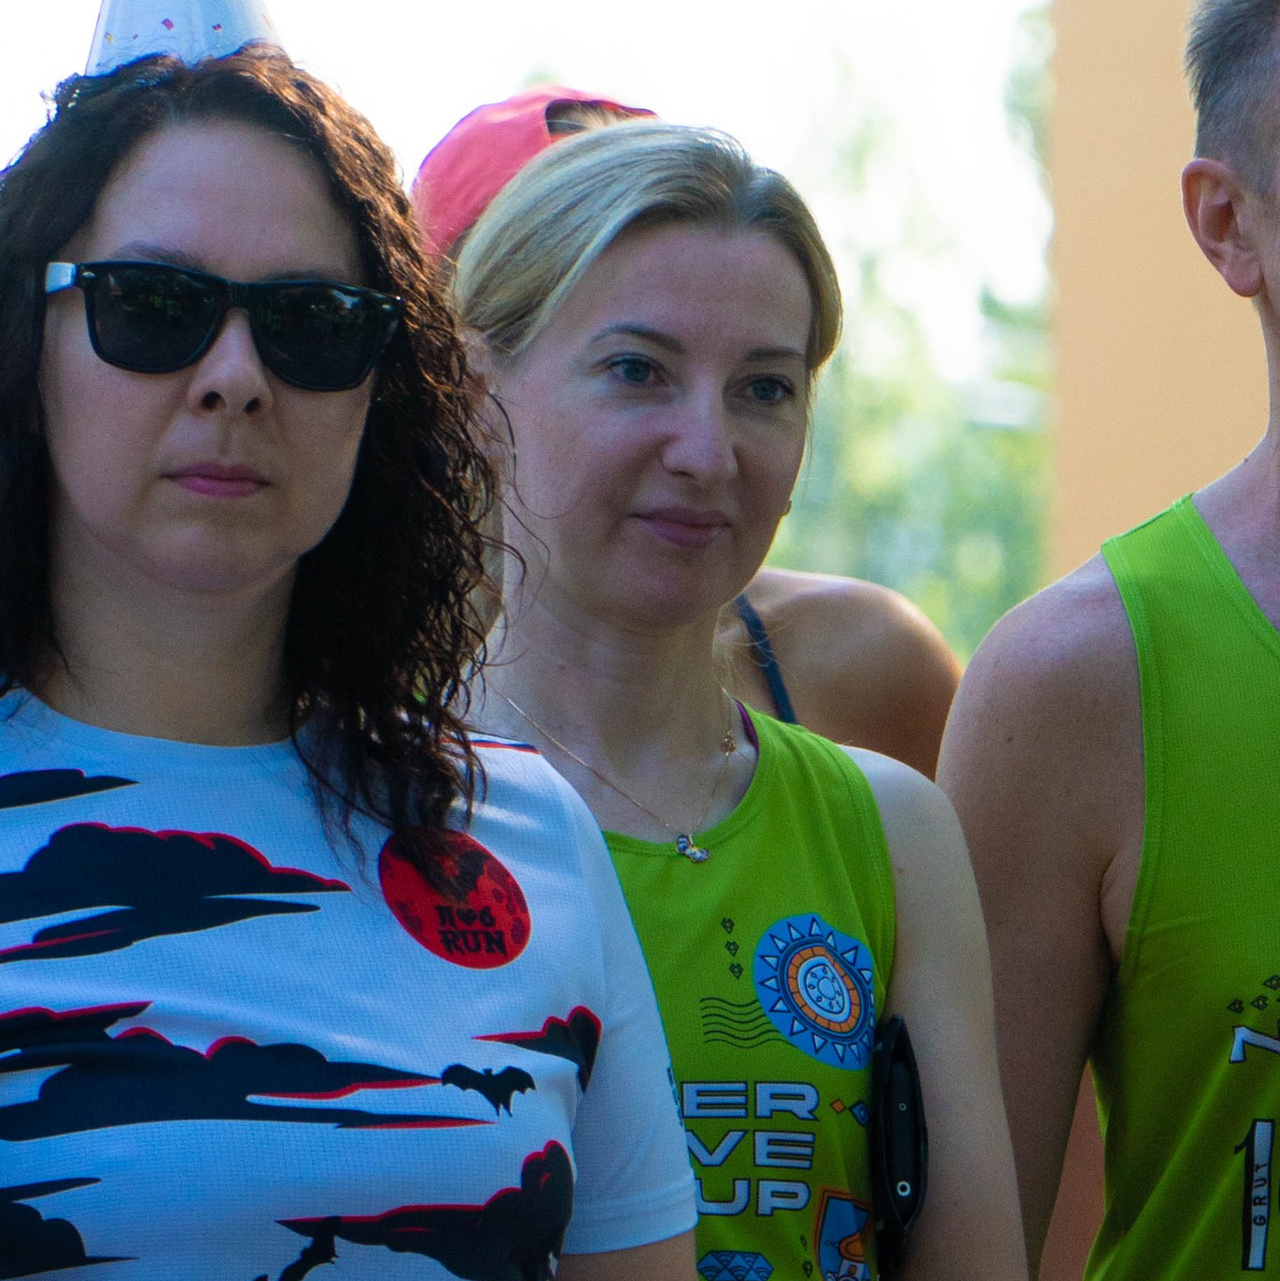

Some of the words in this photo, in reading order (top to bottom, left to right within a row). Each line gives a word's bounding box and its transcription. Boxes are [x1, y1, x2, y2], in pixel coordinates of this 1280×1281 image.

[438, 929, 507, 957] RUN
[694, 1177, 811, 1216] UP
[1252, 1162, 1268, 1227] GRUT
